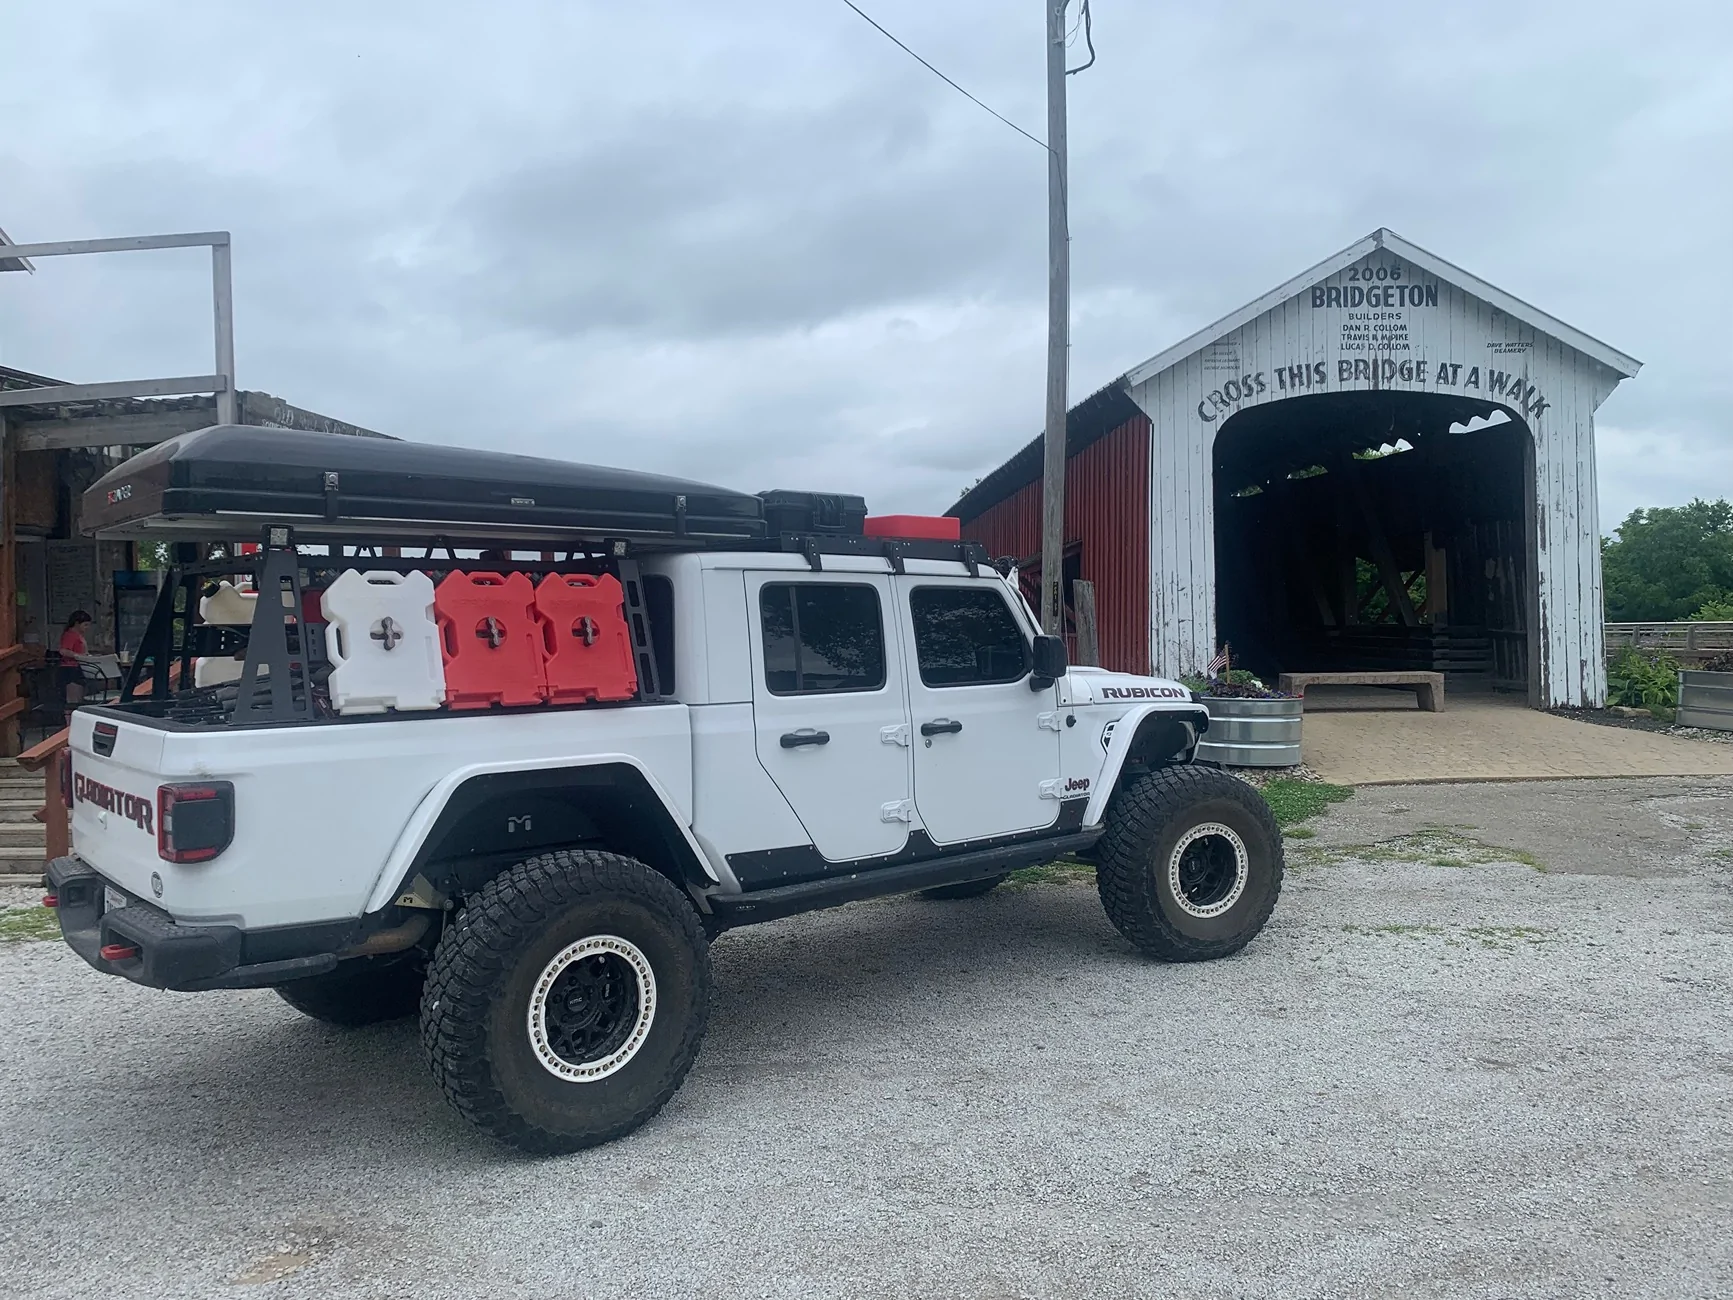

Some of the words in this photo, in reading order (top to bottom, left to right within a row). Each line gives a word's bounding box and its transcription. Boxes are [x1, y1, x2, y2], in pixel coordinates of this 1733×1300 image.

[1348, 267, 1401, 281] 2006
[1311, 284, 1438, 309] BRIDGETON
[1348, 312, 1402, 321] BUILDERS
[1342, 324, 1361, 332] DAN
[1373, 324, 1408, 332] COLLOM
[1341, 333, 1369, 341] TRAVIS
[1341, 343, 1365, 351] LUCAS
[1378, 343, 1410, 351] COLLOM
[1197, 371, 1267, 423] CROSS
[1273, 361, 1327, 390] THIS
[1337, 358, 1428, 384] BRIDGE
[1435, 362, 1463, 386] AT
[1463, 366, 1480, 389] A
[1488, 369, 1551, 419] WALK
[1101, 687, 1186, 699] RUBICON
[1064, 777, 1090, 791] Jeep
[74, 771, 155, 836] GLADIATOR
